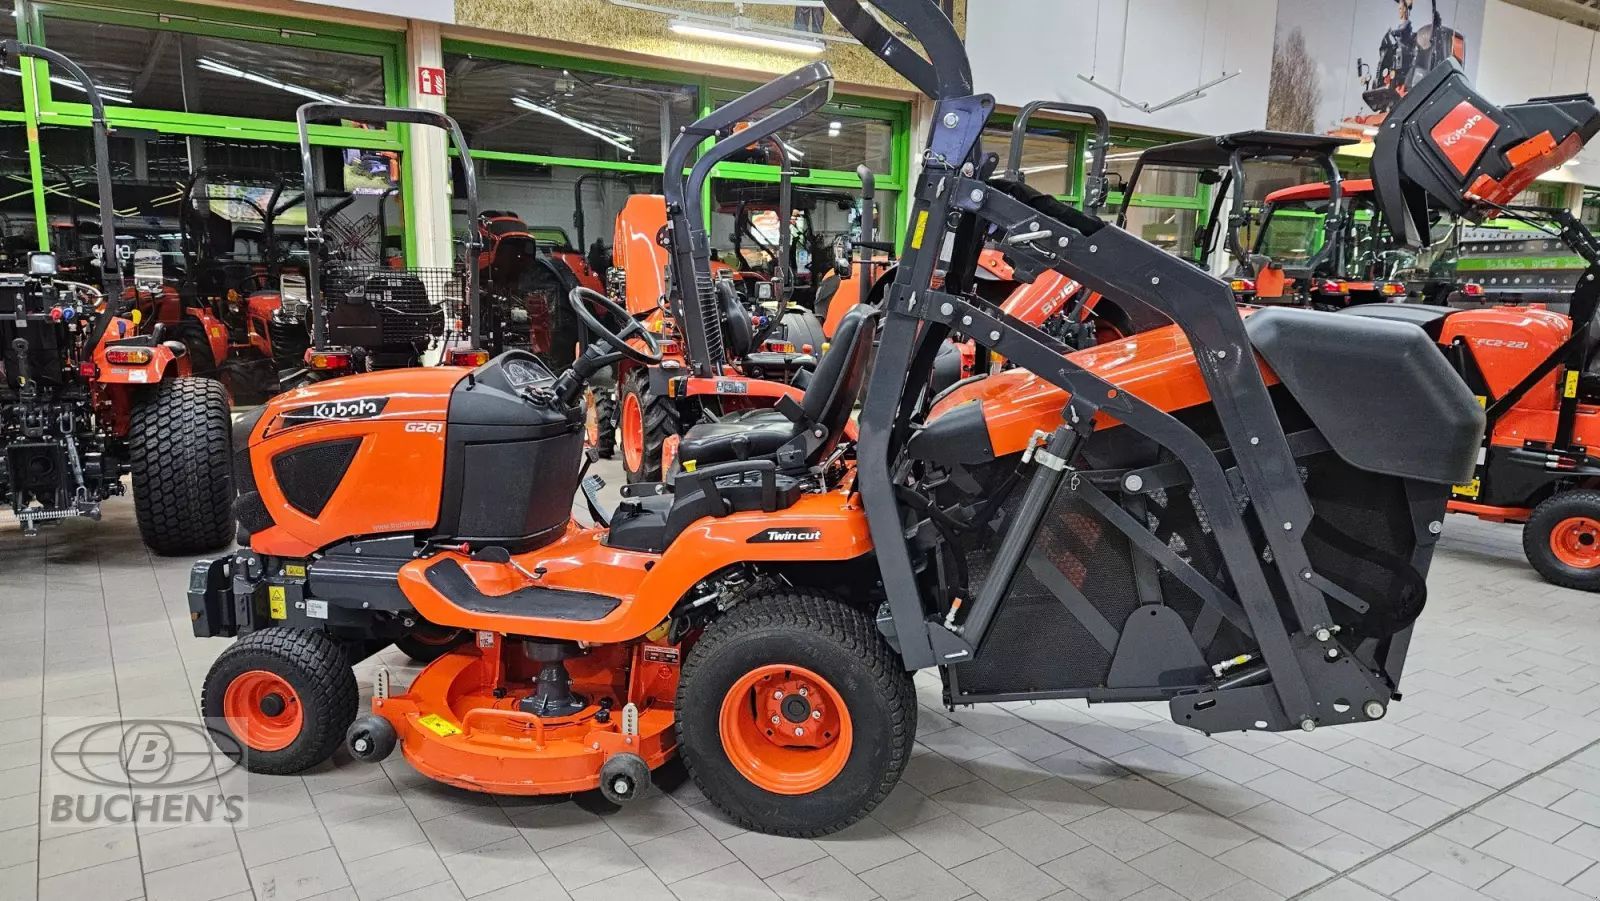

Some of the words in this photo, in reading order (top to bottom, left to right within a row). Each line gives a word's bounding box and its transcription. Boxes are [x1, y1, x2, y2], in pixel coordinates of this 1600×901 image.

[1443, 114, 1482, 147] Kubota
[313, 399, 377, 418] Kubota
[404, 422, 443, 433] G261
